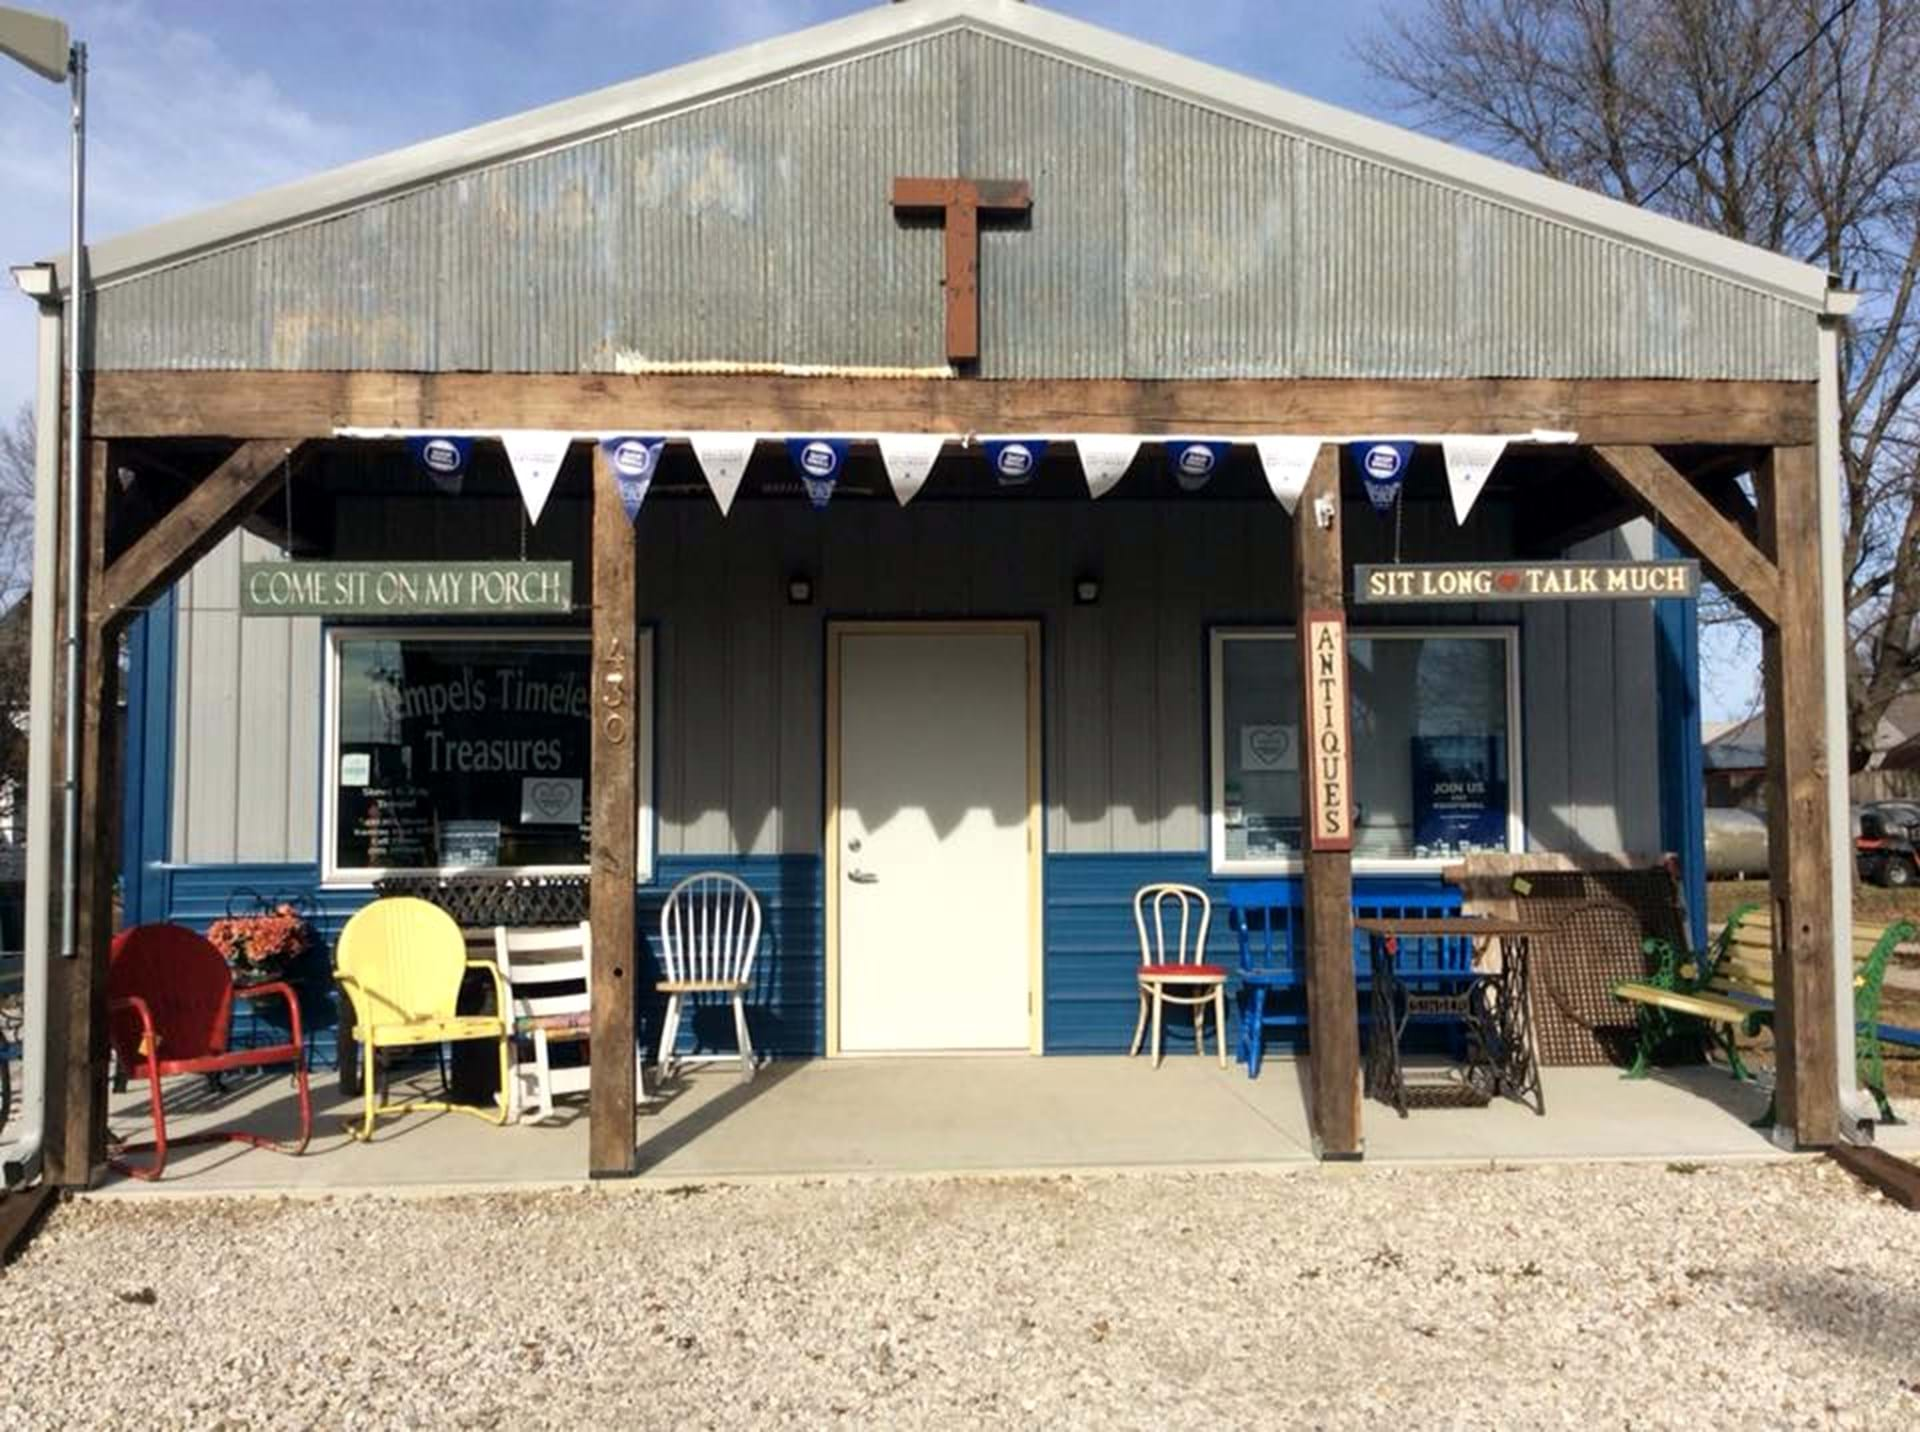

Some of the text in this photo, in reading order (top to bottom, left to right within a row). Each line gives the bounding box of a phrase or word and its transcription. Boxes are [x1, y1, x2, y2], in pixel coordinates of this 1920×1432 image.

[250, 571, 561, 605] COME SIT ON MY PORCH
[1369, 570, 1493, 596] SIT LONG
[1525, 565, 1686, 593] TALK MUCH
[496, 669, 594, 720] Timele
[1316, 625, 1341, 834] ANTIQUES
[424, 730, 563, 771] Treasures
